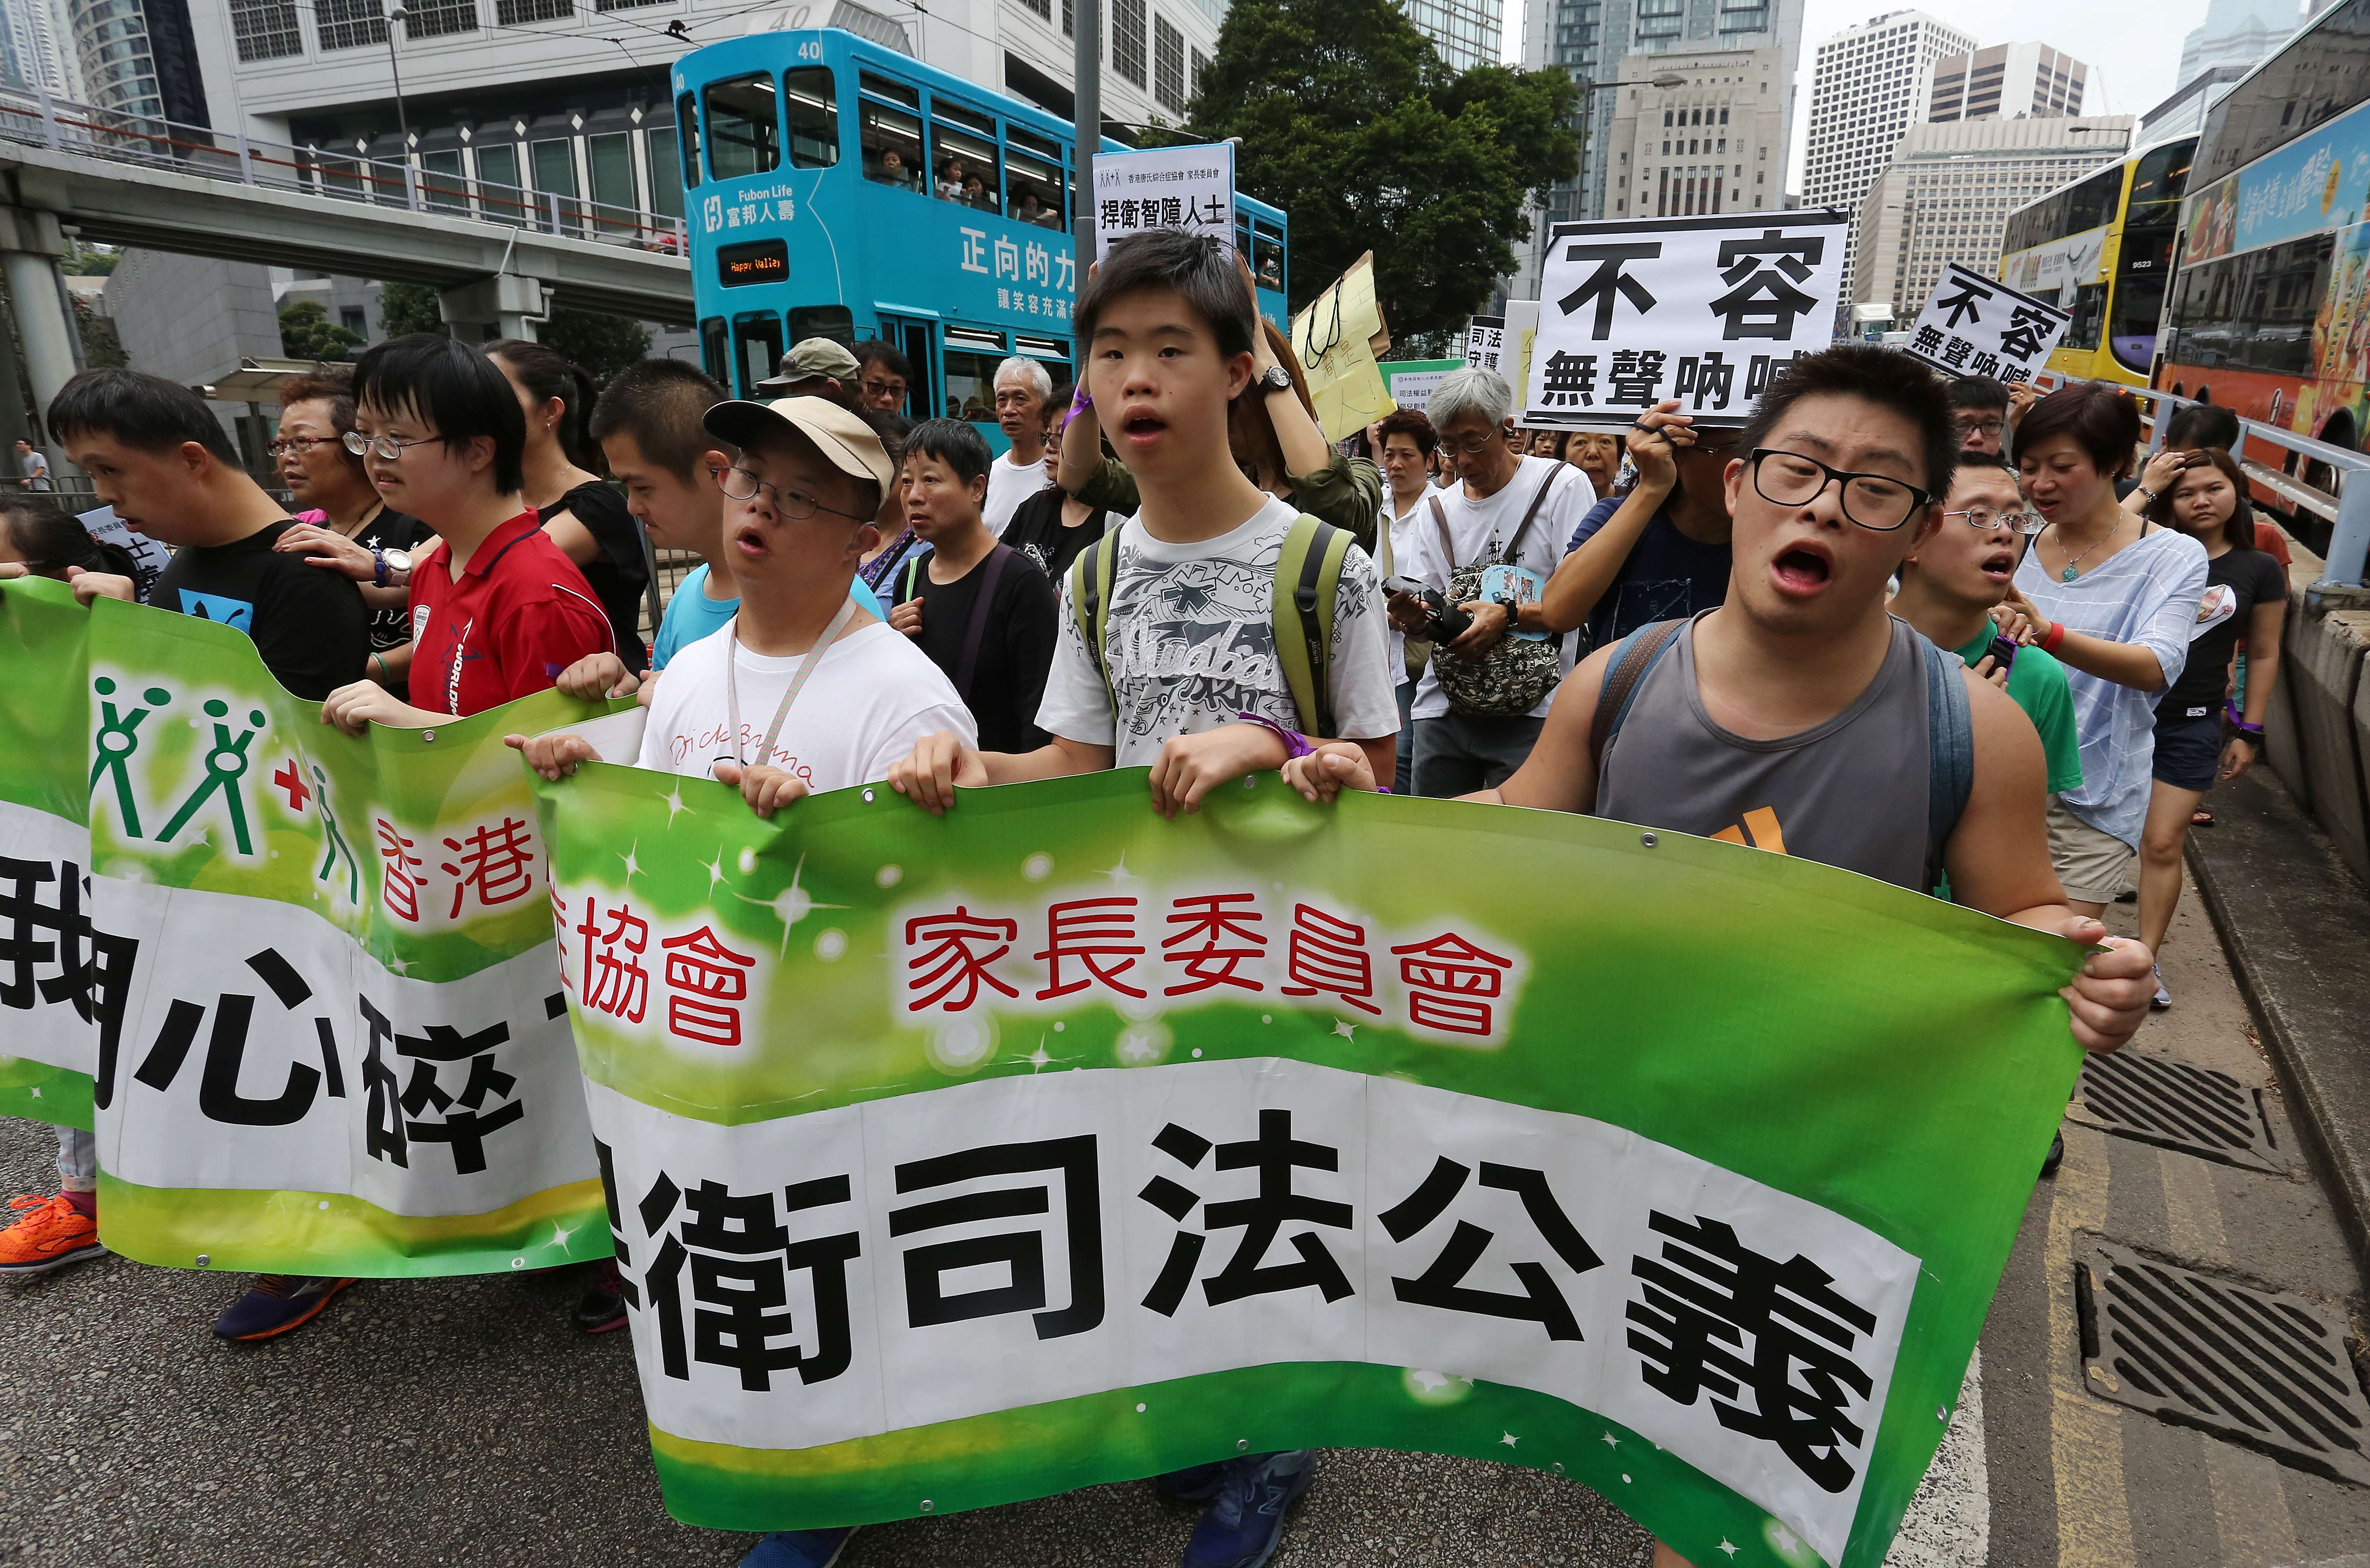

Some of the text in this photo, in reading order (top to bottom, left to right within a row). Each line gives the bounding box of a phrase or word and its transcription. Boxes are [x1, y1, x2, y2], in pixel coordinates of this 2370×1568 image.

[798, 42, 820, 60] 40
[676, 73, 685, 90] 40
[738, 185, 793, 202] Fubon Life
[727, 200, 795, 228] 富邦人壽
[1101, 194, 1225, 230] 捍衛智障人士
[731, 258, 781, 272] Happy Valley
[1472, 328, 1501, 348] 司法
[670, 723, 731, 766] Dick
[377, 817, 533, 922] 香港
[905, 893, 1512, 1036] 家長委員會
[92, 927, 568, 1175] 心碎
[593, 1109, 1877, 1494] 衛司法公義
